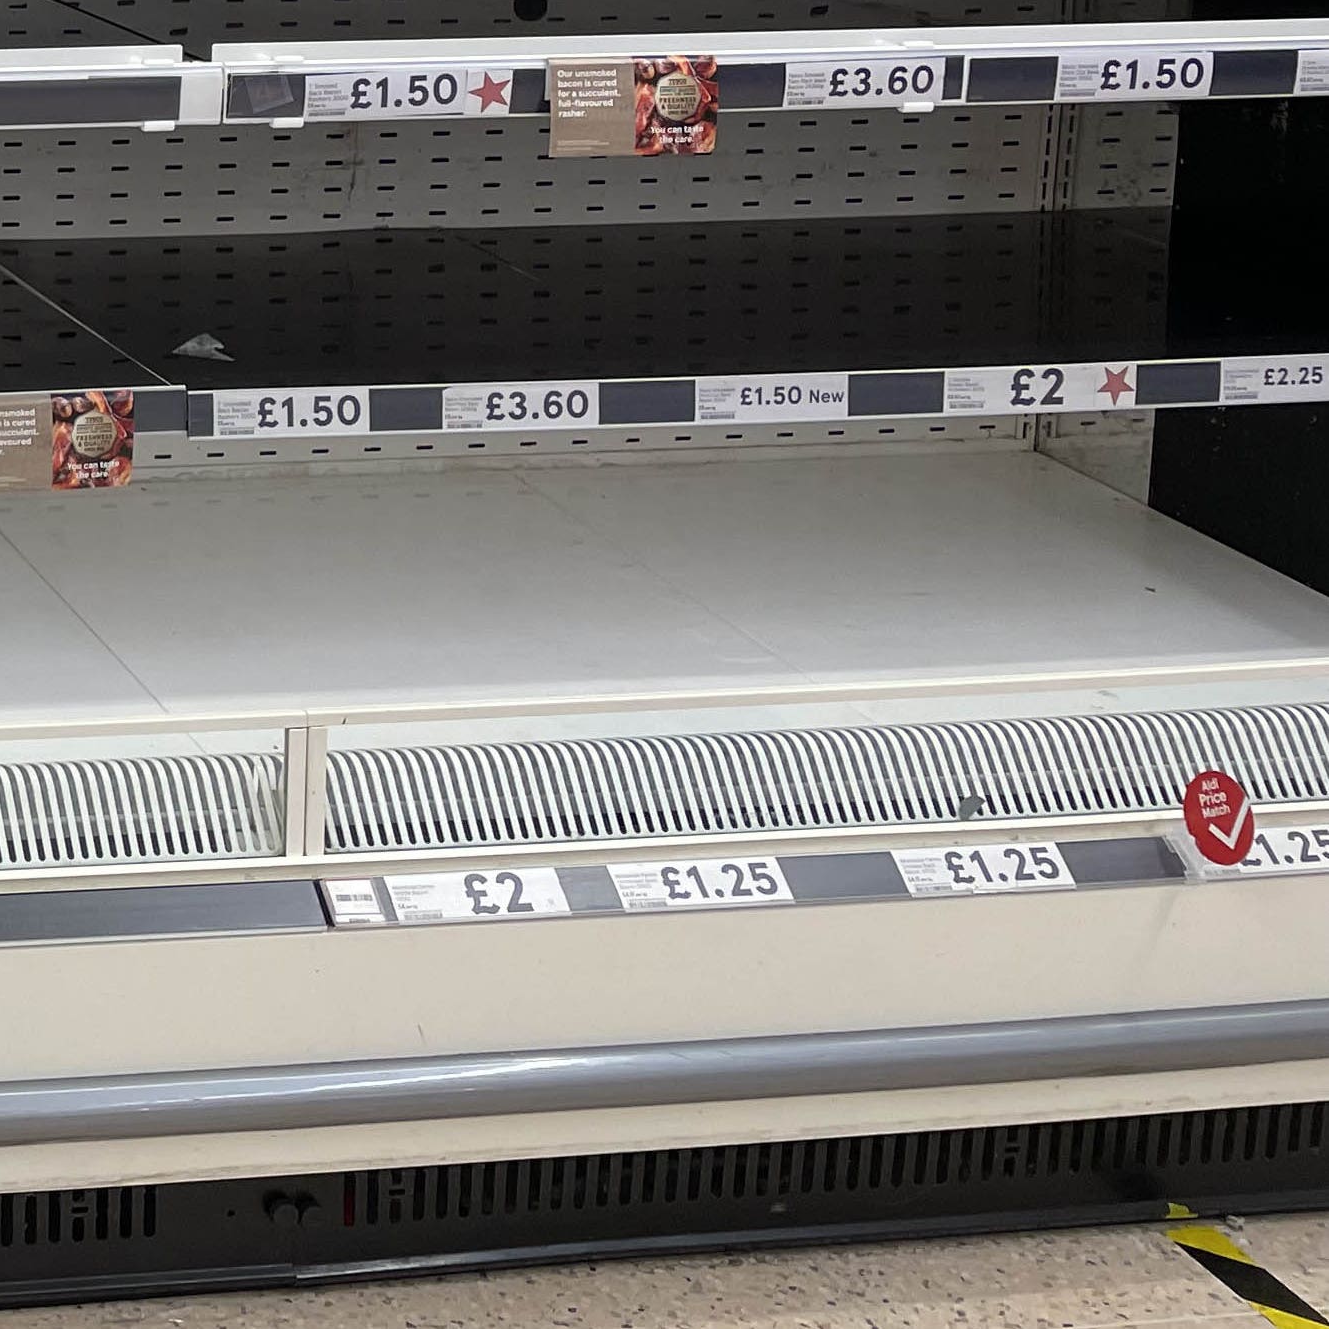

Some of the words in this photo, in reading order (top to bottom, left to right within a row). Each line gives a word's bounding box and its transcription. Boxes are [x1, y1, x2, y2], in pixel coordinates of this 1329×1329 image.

[557, 70, 572, 78] Our
[575, 70, 616, 78] unsmoked
[829, 66, 933, 96] £3.60
[1100, 58, 1203, 90] £1.50
[350, 73, 458, 109] £1.50
[558, 80, 582, 88] bacon
[584, 79, 591, 87] is
[592, 79, 617, 87] cured
[558, 90, 570, 98] for
[558, 99, 614, 108] full-flavoured
[558, 109, 587, 118] rasher.
[651, 126, 665, 134] You
[1264, 366, 1322, 385] £2.25
[741, 386, 801, 405] £1.50
[810, 390, 844, 403] New
[1011, 368, 1063, 406] £2
[258, 395, 360, 428] £1.50
[486, 390, 588, 420] £3.60
[3, 419, 10, 427] is
[12, 418, 35, 426] cured
[68, 462, 81, 470] You
[1201, 778, 1219, 791] Aldi
[1198, 791, 1227, 806] Price
[1201, 804, 1231, 819] Match
[945, 847, 1060, 884] £1.25
[661, 862, 778, 899] £1.25
[464, 872, 534, 914] £2
